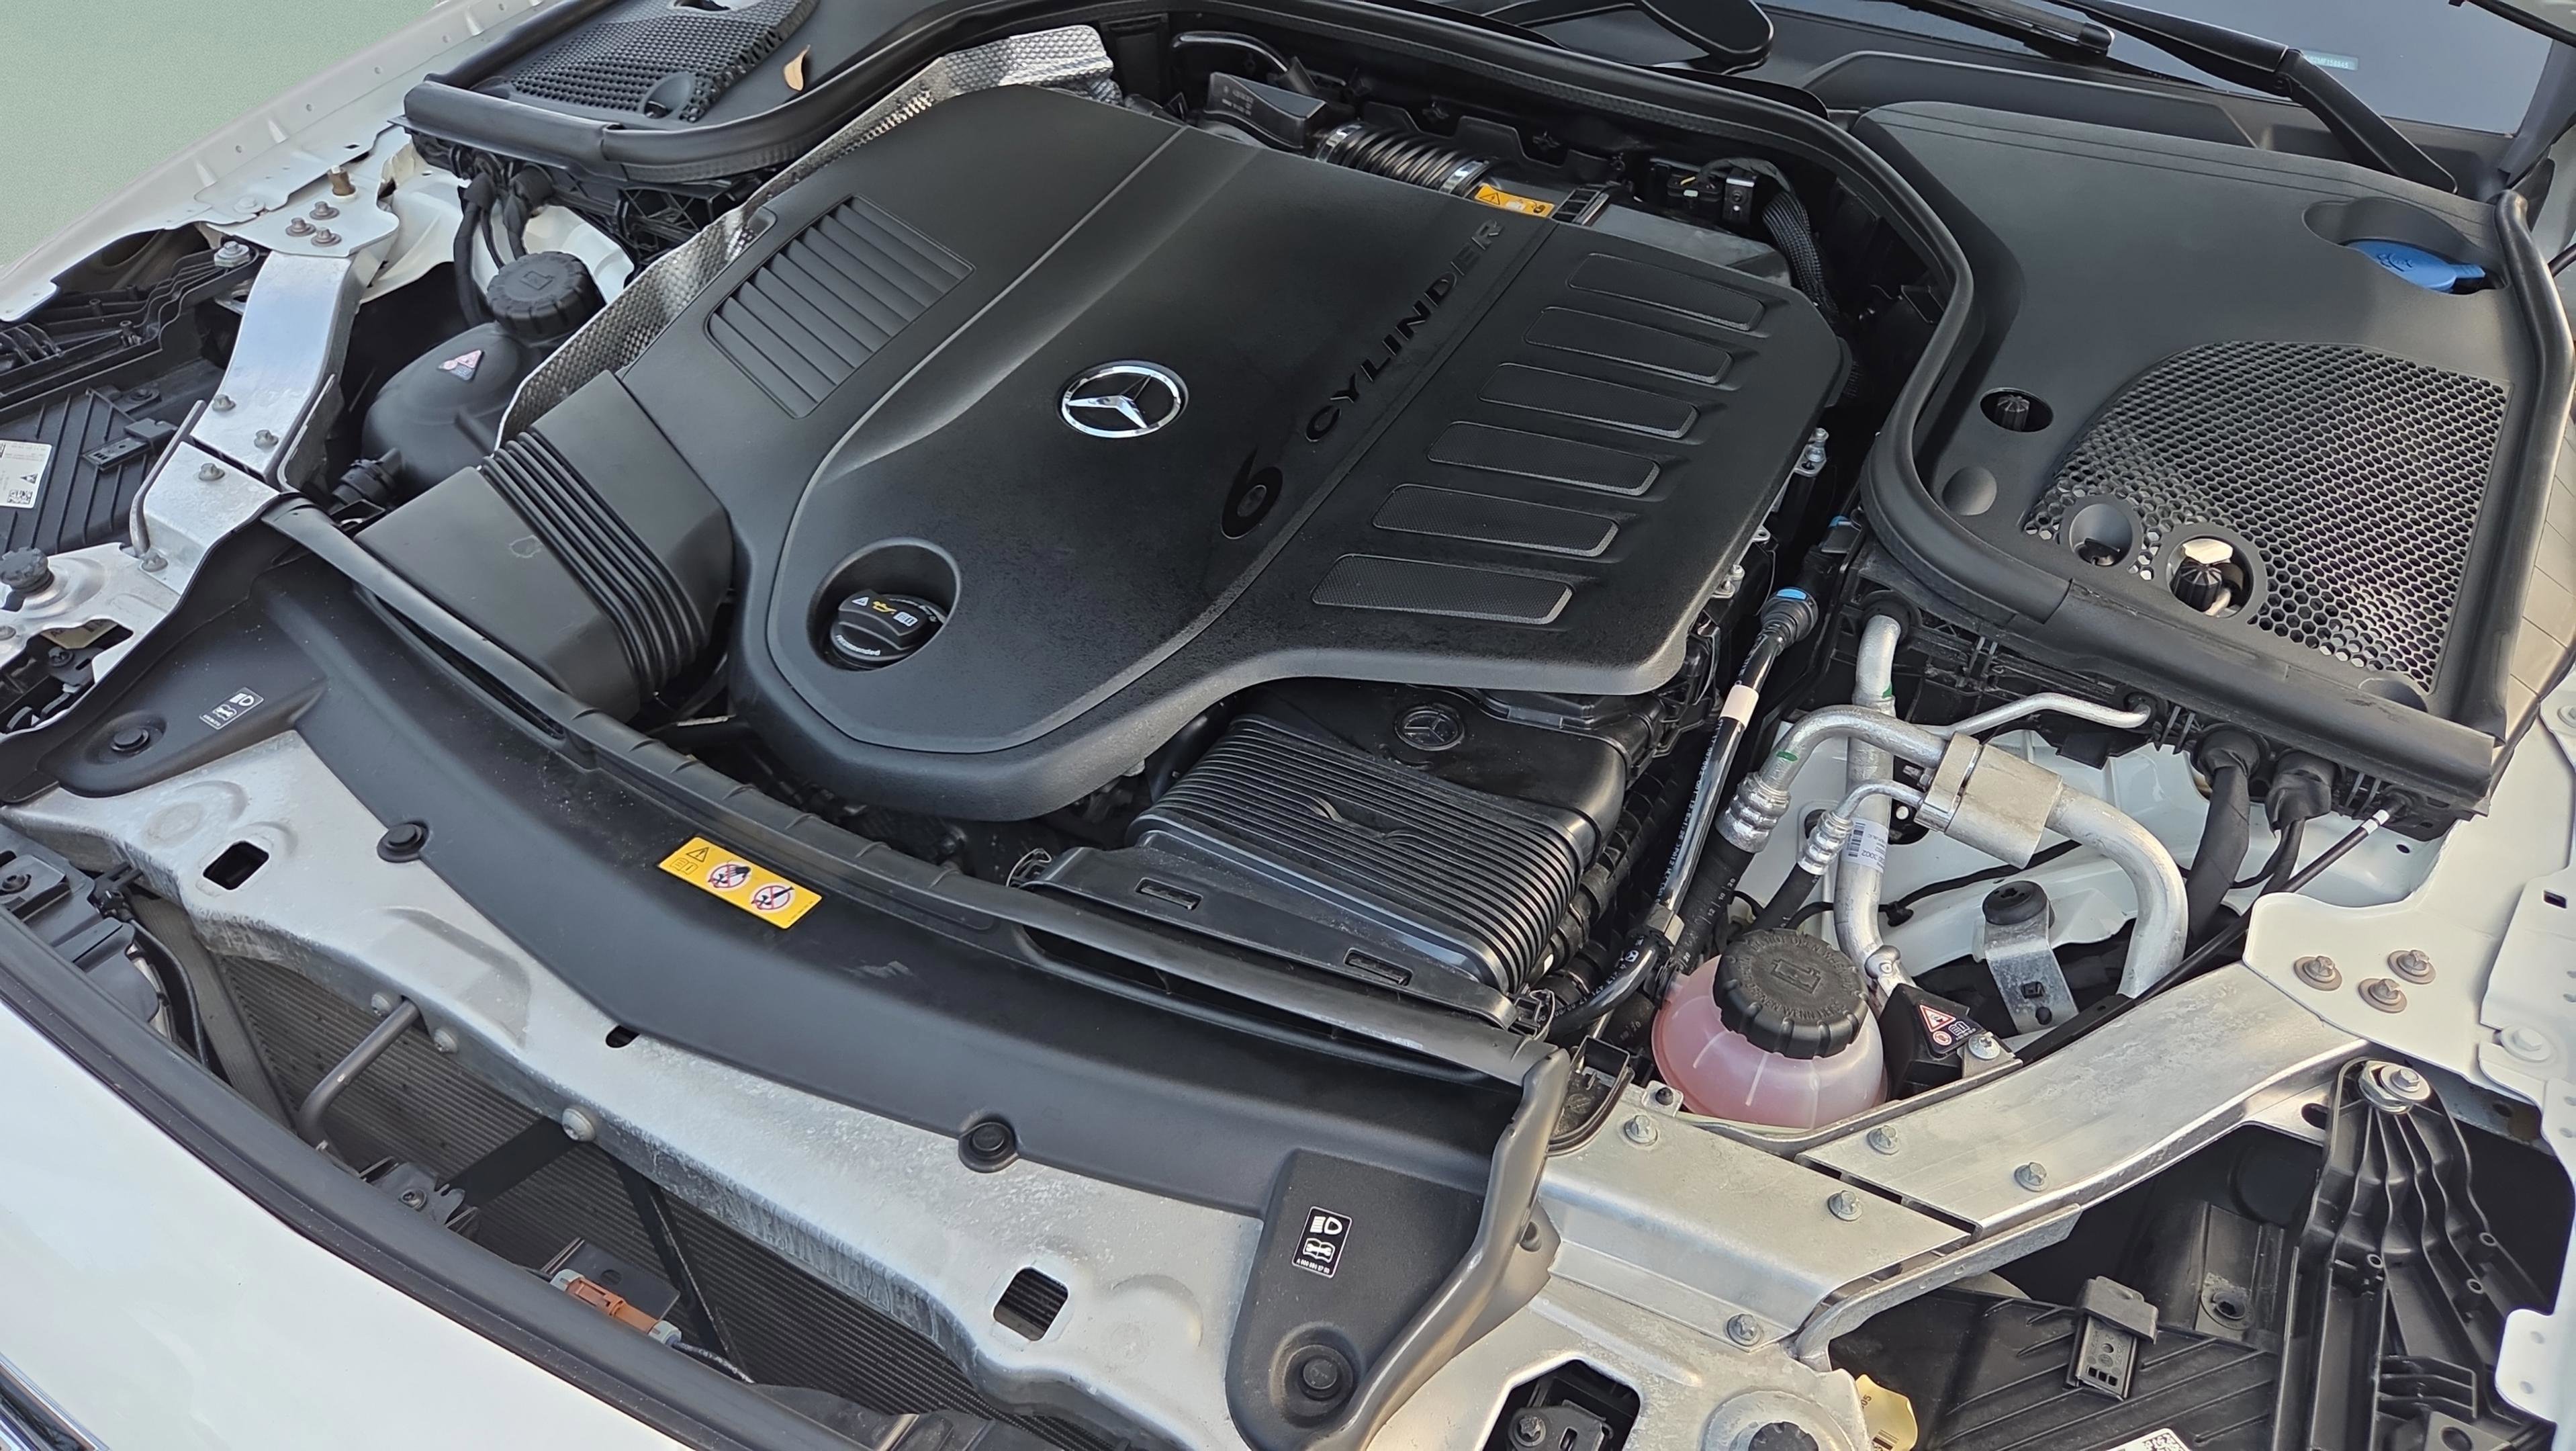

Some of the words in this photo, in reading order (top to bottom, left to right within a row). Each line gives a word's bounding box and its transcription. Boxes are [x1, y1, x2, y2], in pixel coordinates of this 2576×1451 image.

[1221, 445, 1283, 539] 6
[1305, 219, 1504, 443] CYLINDER
[835, 634, 881, 656] recommended
[1860, 1394, 1872, 1409] 05
